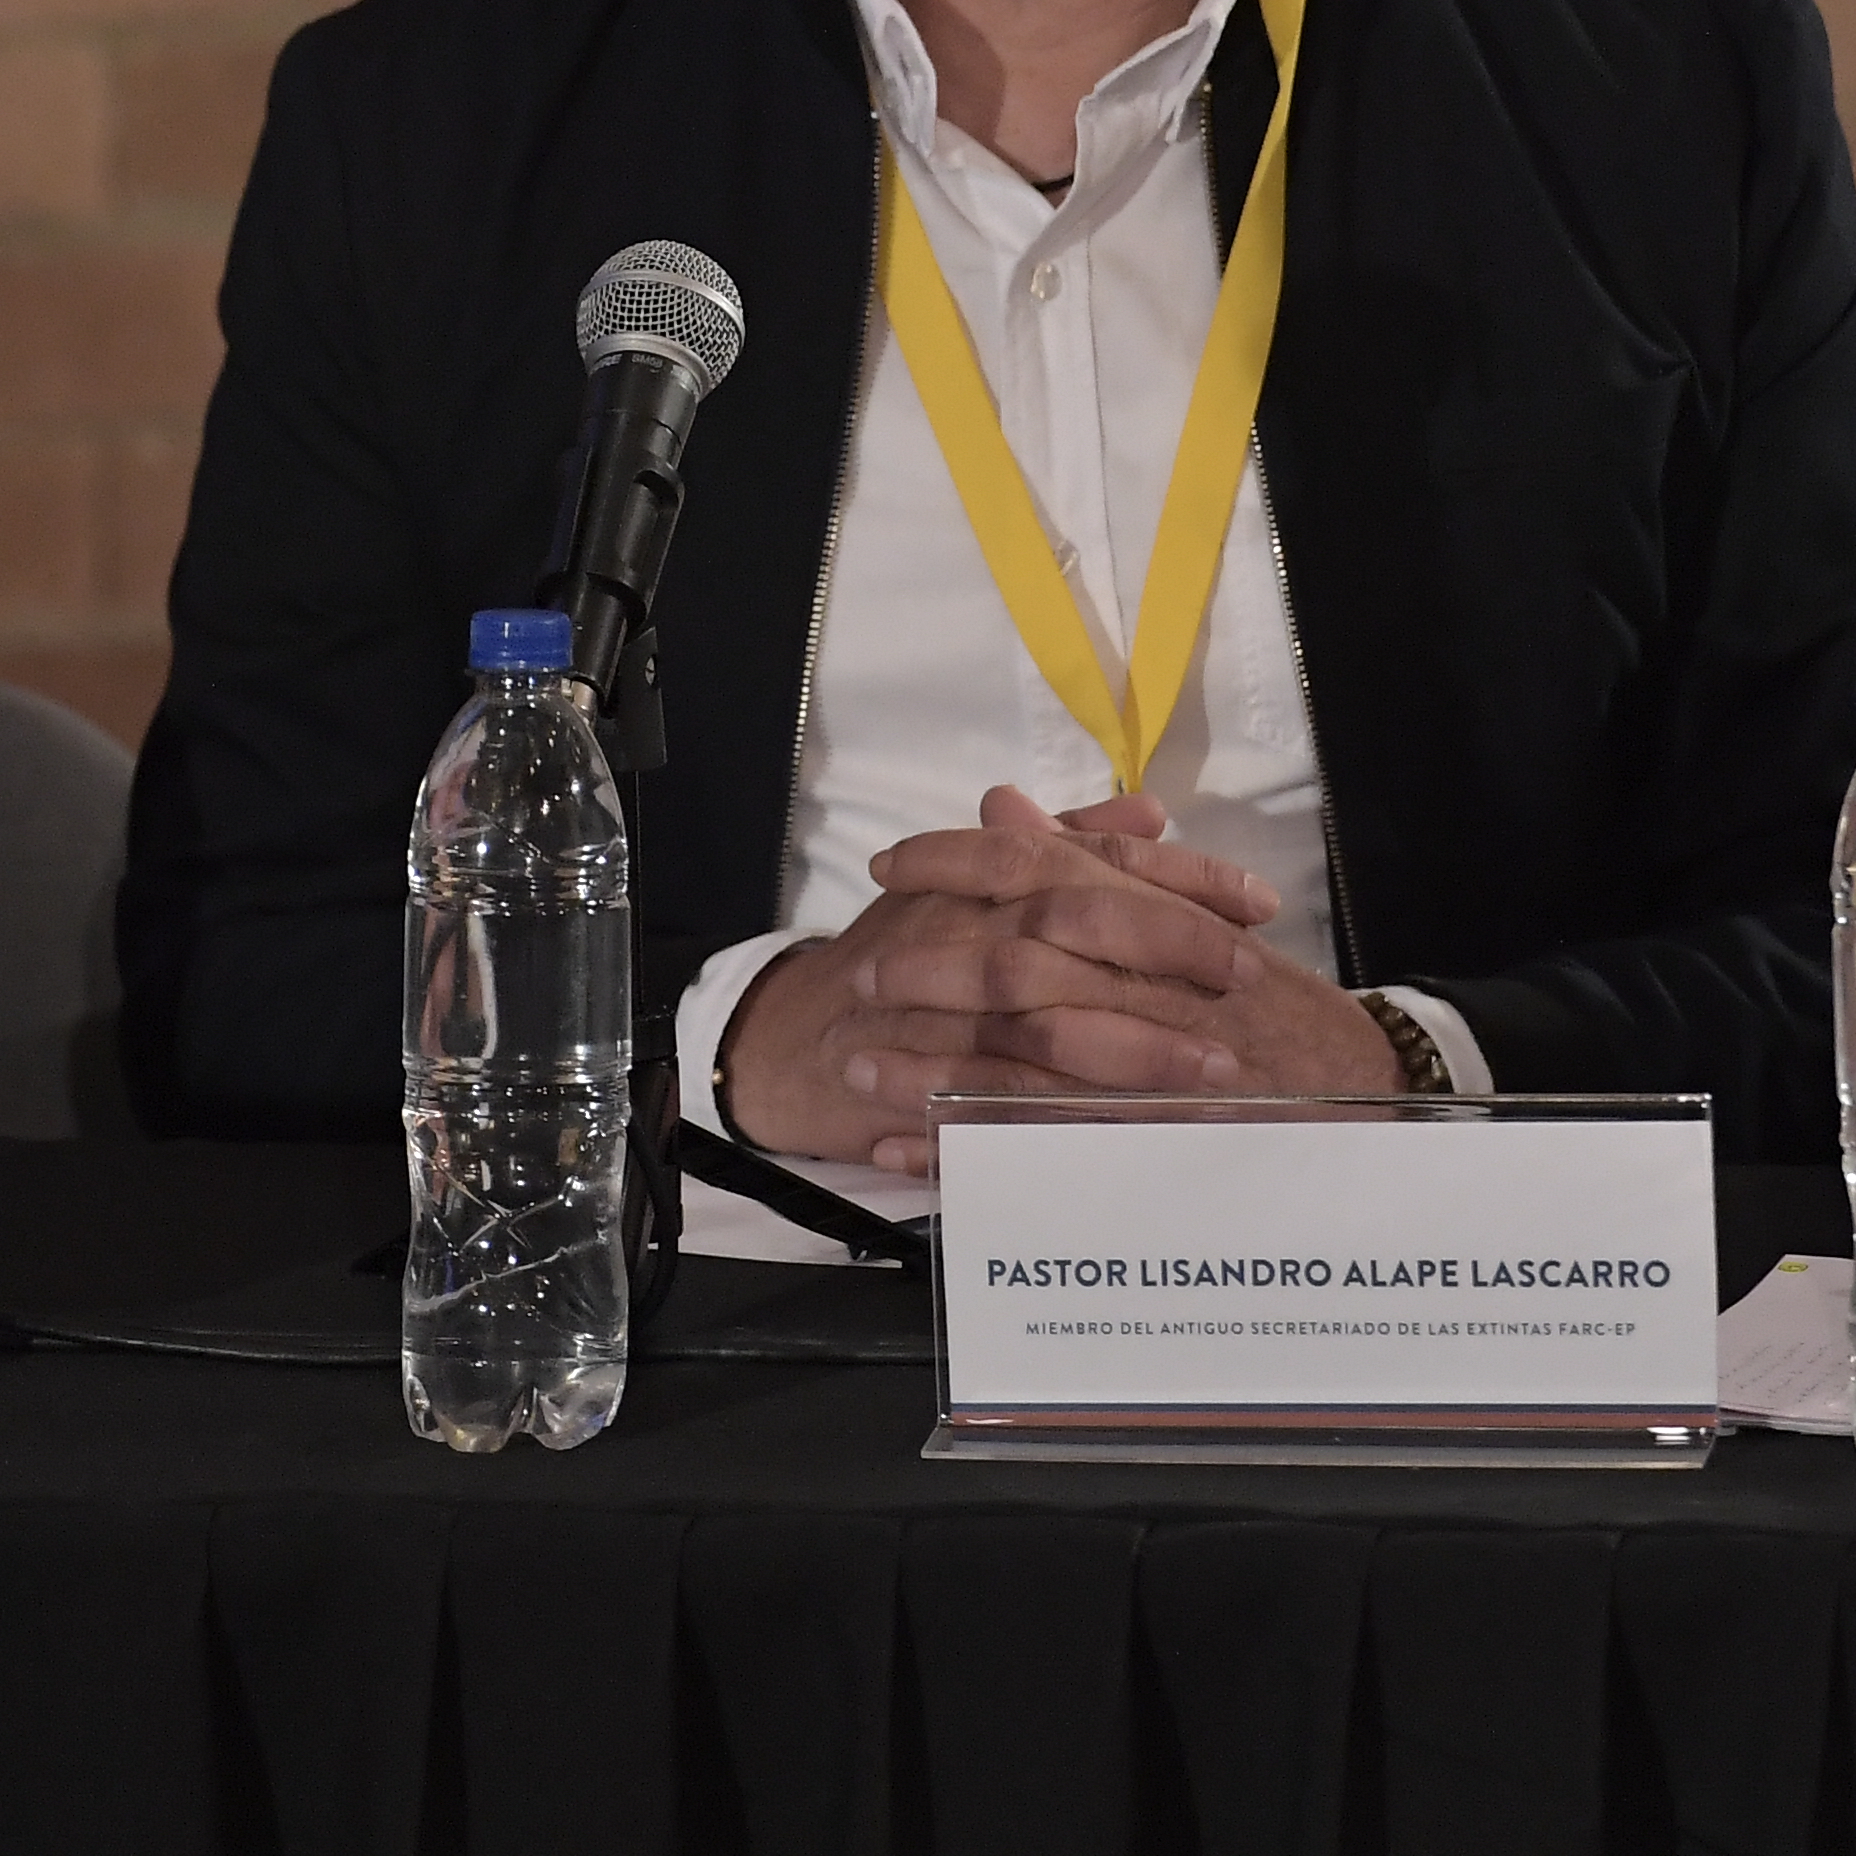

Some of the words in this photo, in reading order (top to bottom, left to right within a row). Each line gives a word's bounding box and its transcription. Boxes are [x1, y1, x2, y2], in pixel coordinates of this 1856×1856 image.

[986, 1258, 1128, 1288] PASTOR
[1139, 1258, 1333, 1288] LISANDRO
[1341, 1258, 1460, 1288] ALAPE
[1470, 1259, 1672, 1289] LASCARRO
[1025, 1321, 1114, 1336] MIEMBRO
[1120, 1321, 1154, 1336] DEL
[1160, 1321, 1245, 1336] ANTIGUO
[1250, 1321, 1391, 1336] SECRETARIADO
[1397, 1321, 1421, 1336] DE
[1427, 1322, 1460, 1336] LAS
[1466, 1322, 1552, 1336] EXTINTAS
[1558, 1322, 1636, 1336] FARC-EP
